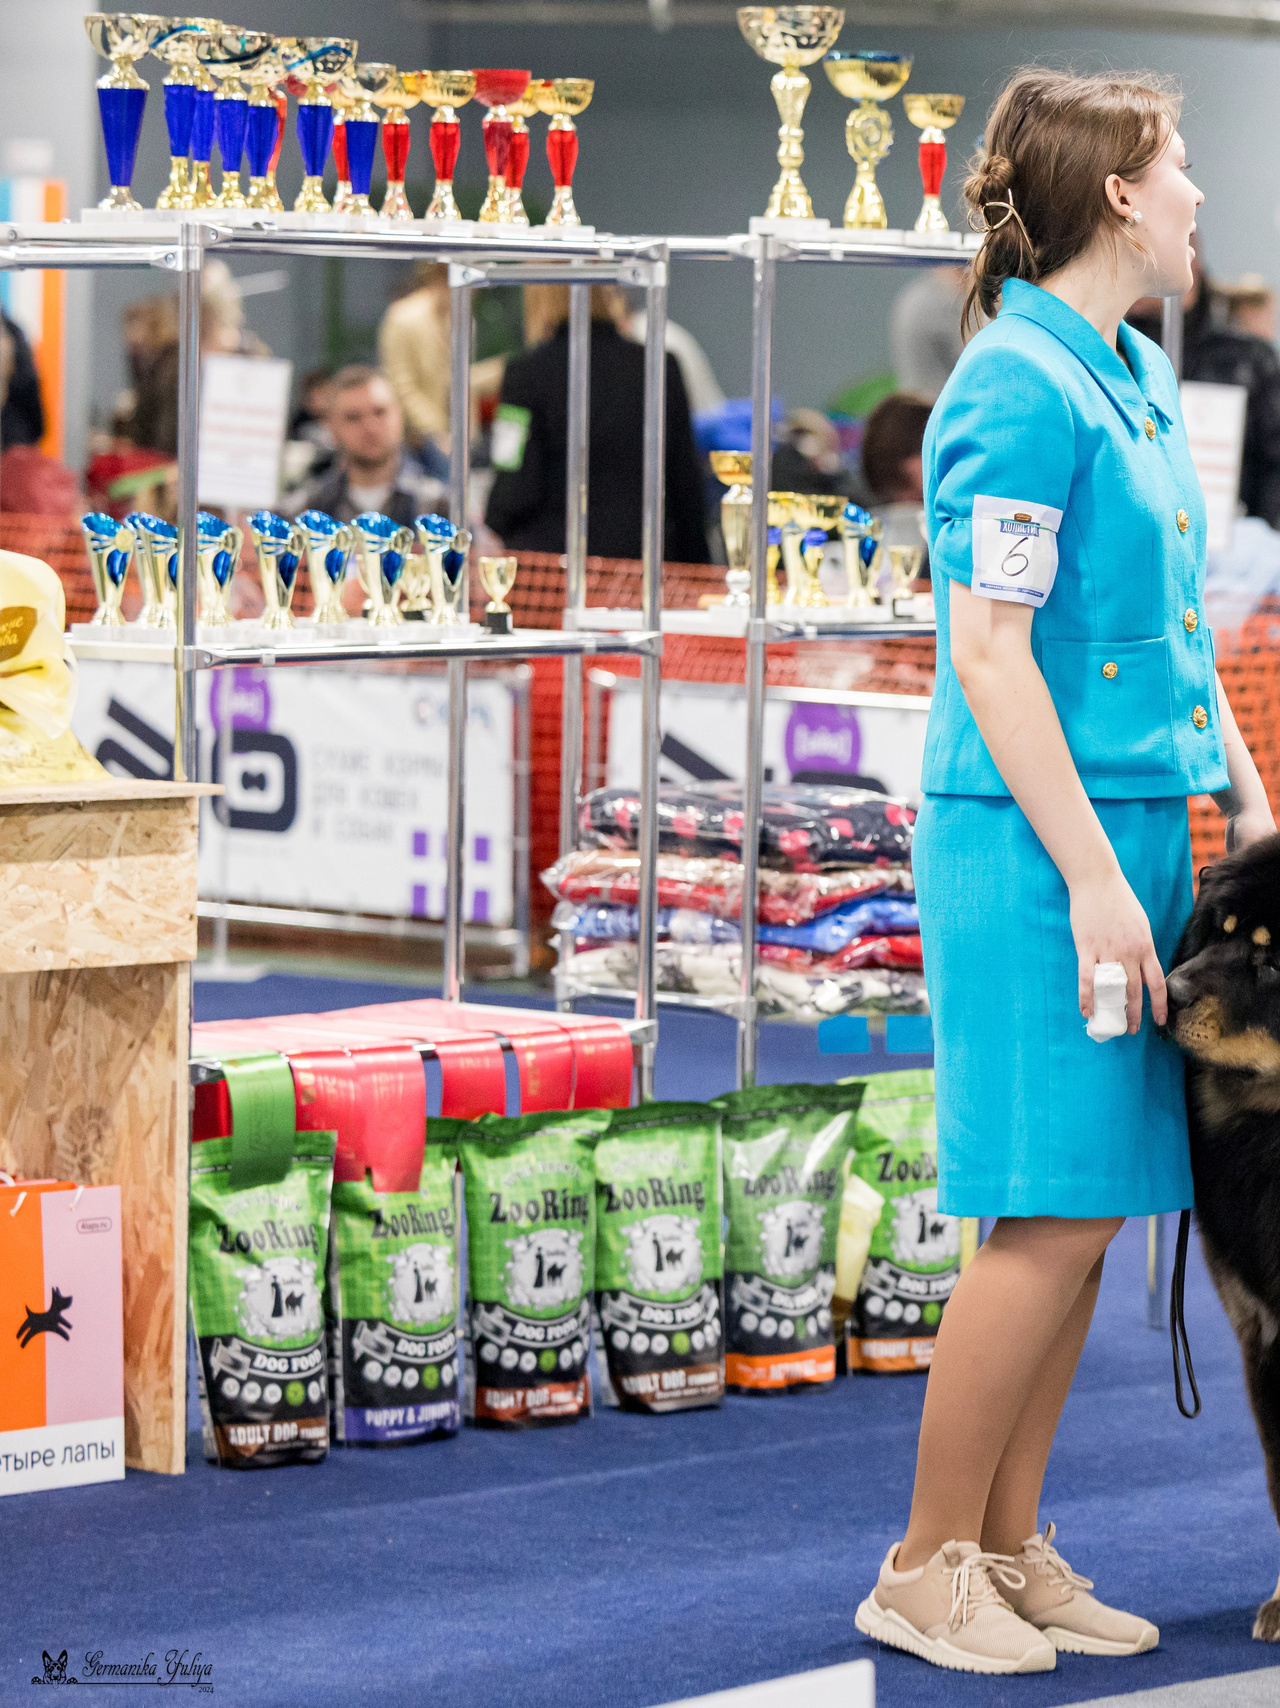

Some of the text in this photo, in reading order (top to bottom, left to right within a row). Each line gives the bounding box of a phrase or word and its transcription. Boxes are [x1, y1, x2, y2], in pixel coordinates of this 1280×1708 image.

[1001, 536, 1029, 577] 6
[875, 1152, 937, 1183] ZooR
[600, 1177, 705, 1213] ZooRing
[366, 1203, 455, 1239] ZooRing
[396, 1332, 455, 1357] DOG FOOD
[253, 1348, 322, 1374] DOG FOOD
[365, 1408, 405, 1427] PUPPY
[229, 1423, 271, 1446] ADULT
[0, 1439, 115, 1473] тыре лапы
